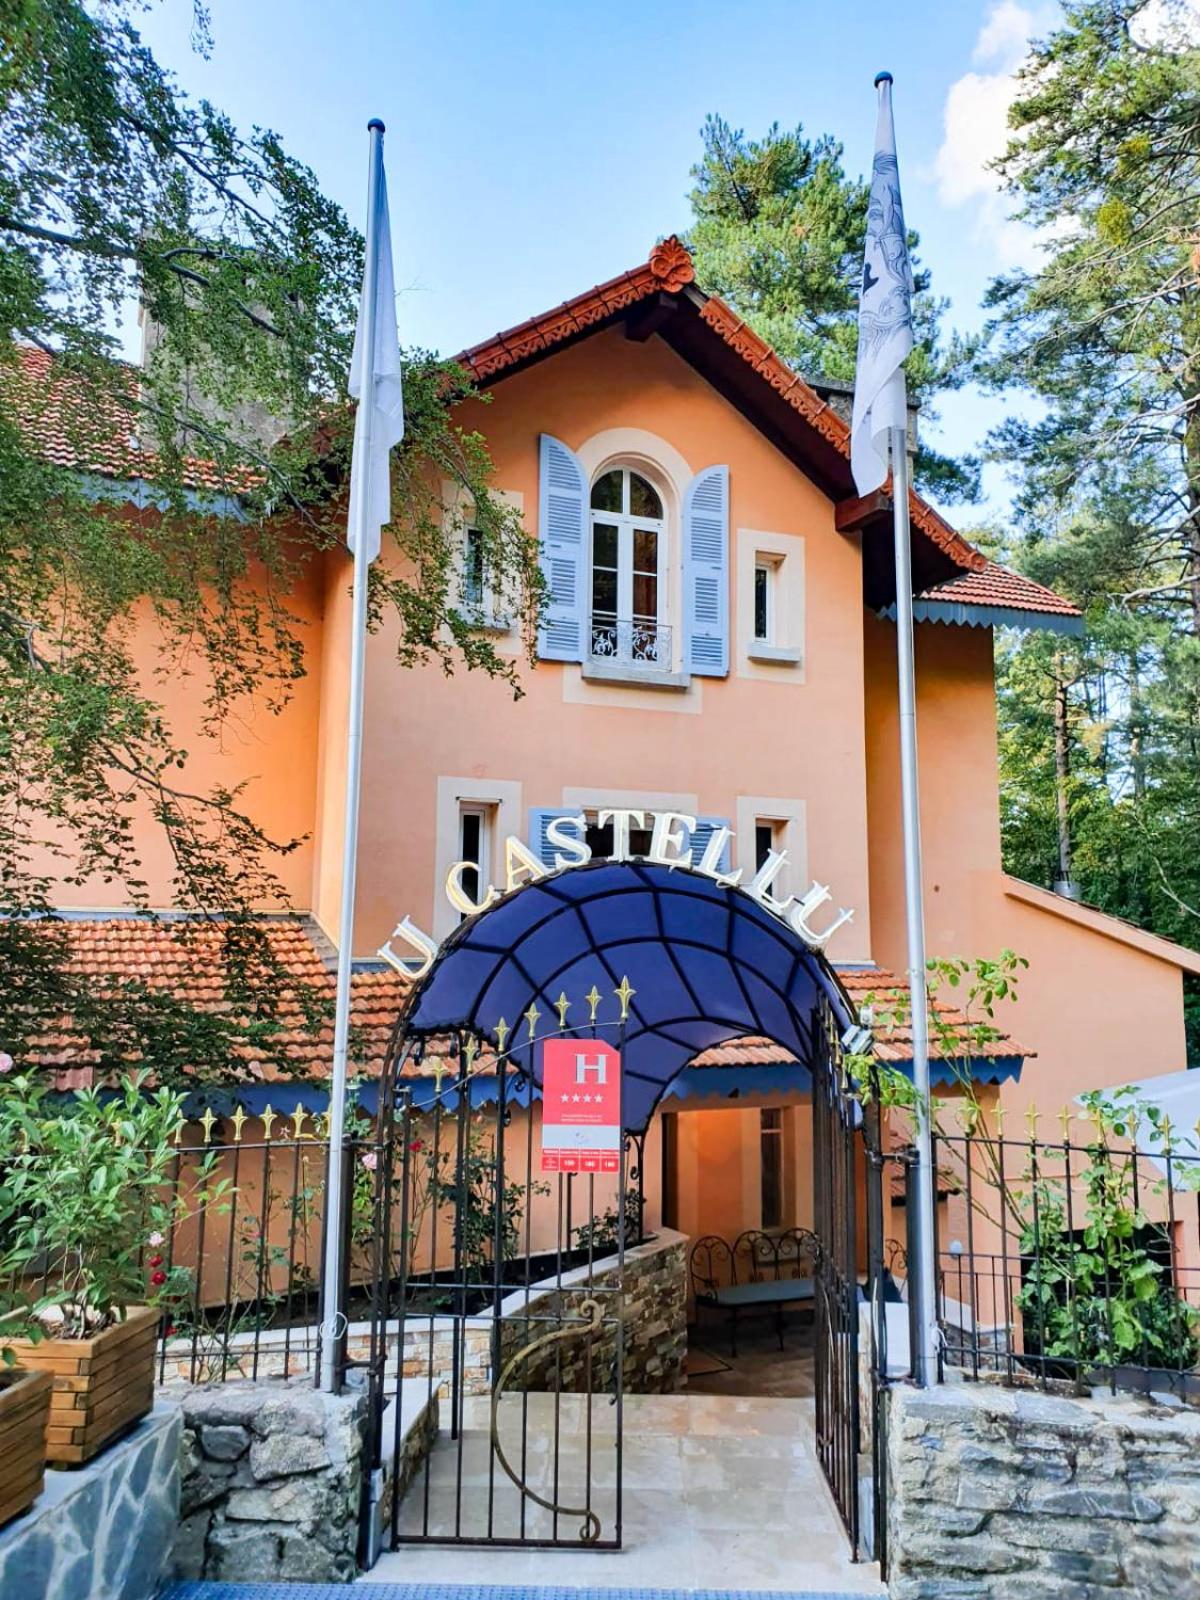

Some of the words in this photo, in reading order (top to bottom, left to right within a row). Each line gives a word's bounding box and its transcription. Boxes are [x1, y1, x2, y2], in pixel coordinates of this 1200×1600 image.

[376, 914, 442, 980] U
[445, 808, 855, 946] CASTELLU
[574, 1053, 608, 1085] H
